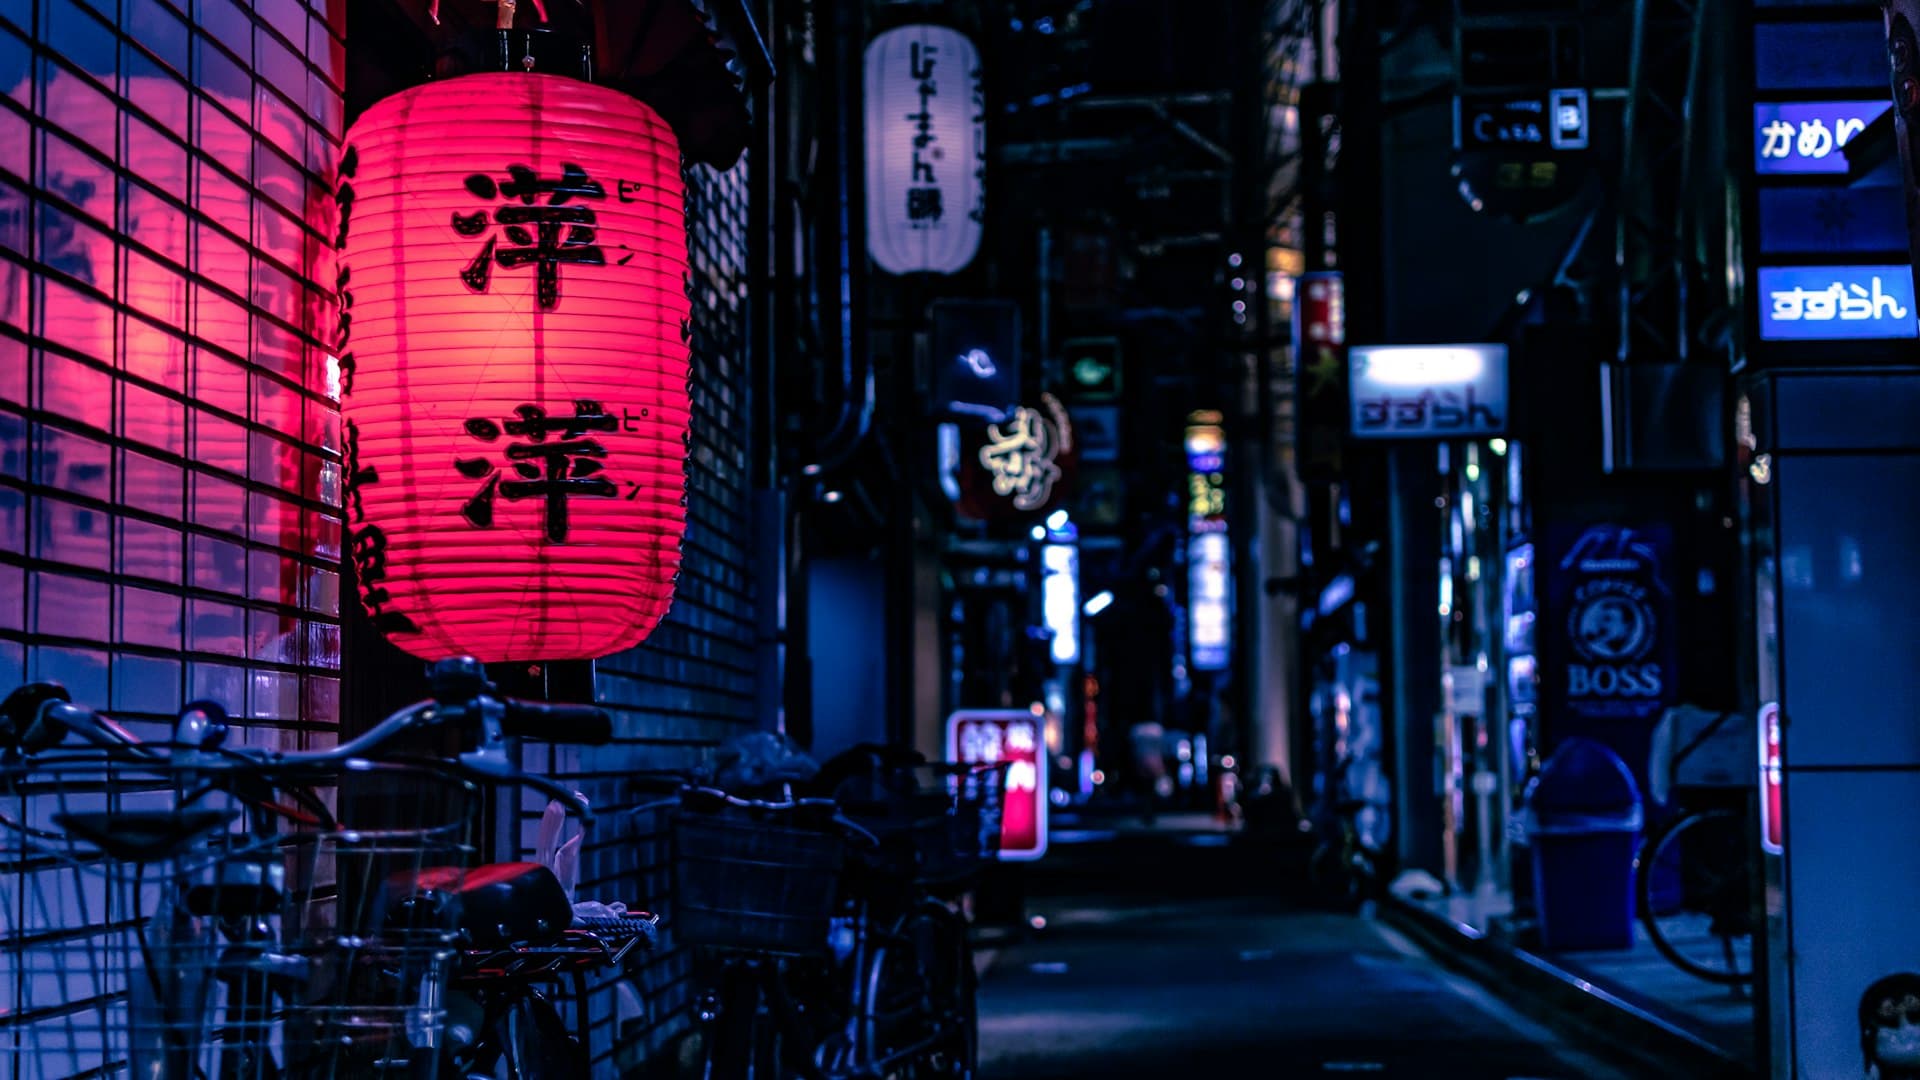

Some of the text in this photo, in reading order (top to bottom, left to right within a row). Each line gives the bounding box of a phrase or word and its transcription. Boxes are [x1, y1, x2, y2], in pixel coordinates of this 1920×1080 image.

[1770, 276, 1907, 320] すずらん
[1567, 662, 1663, 696] BOSS
